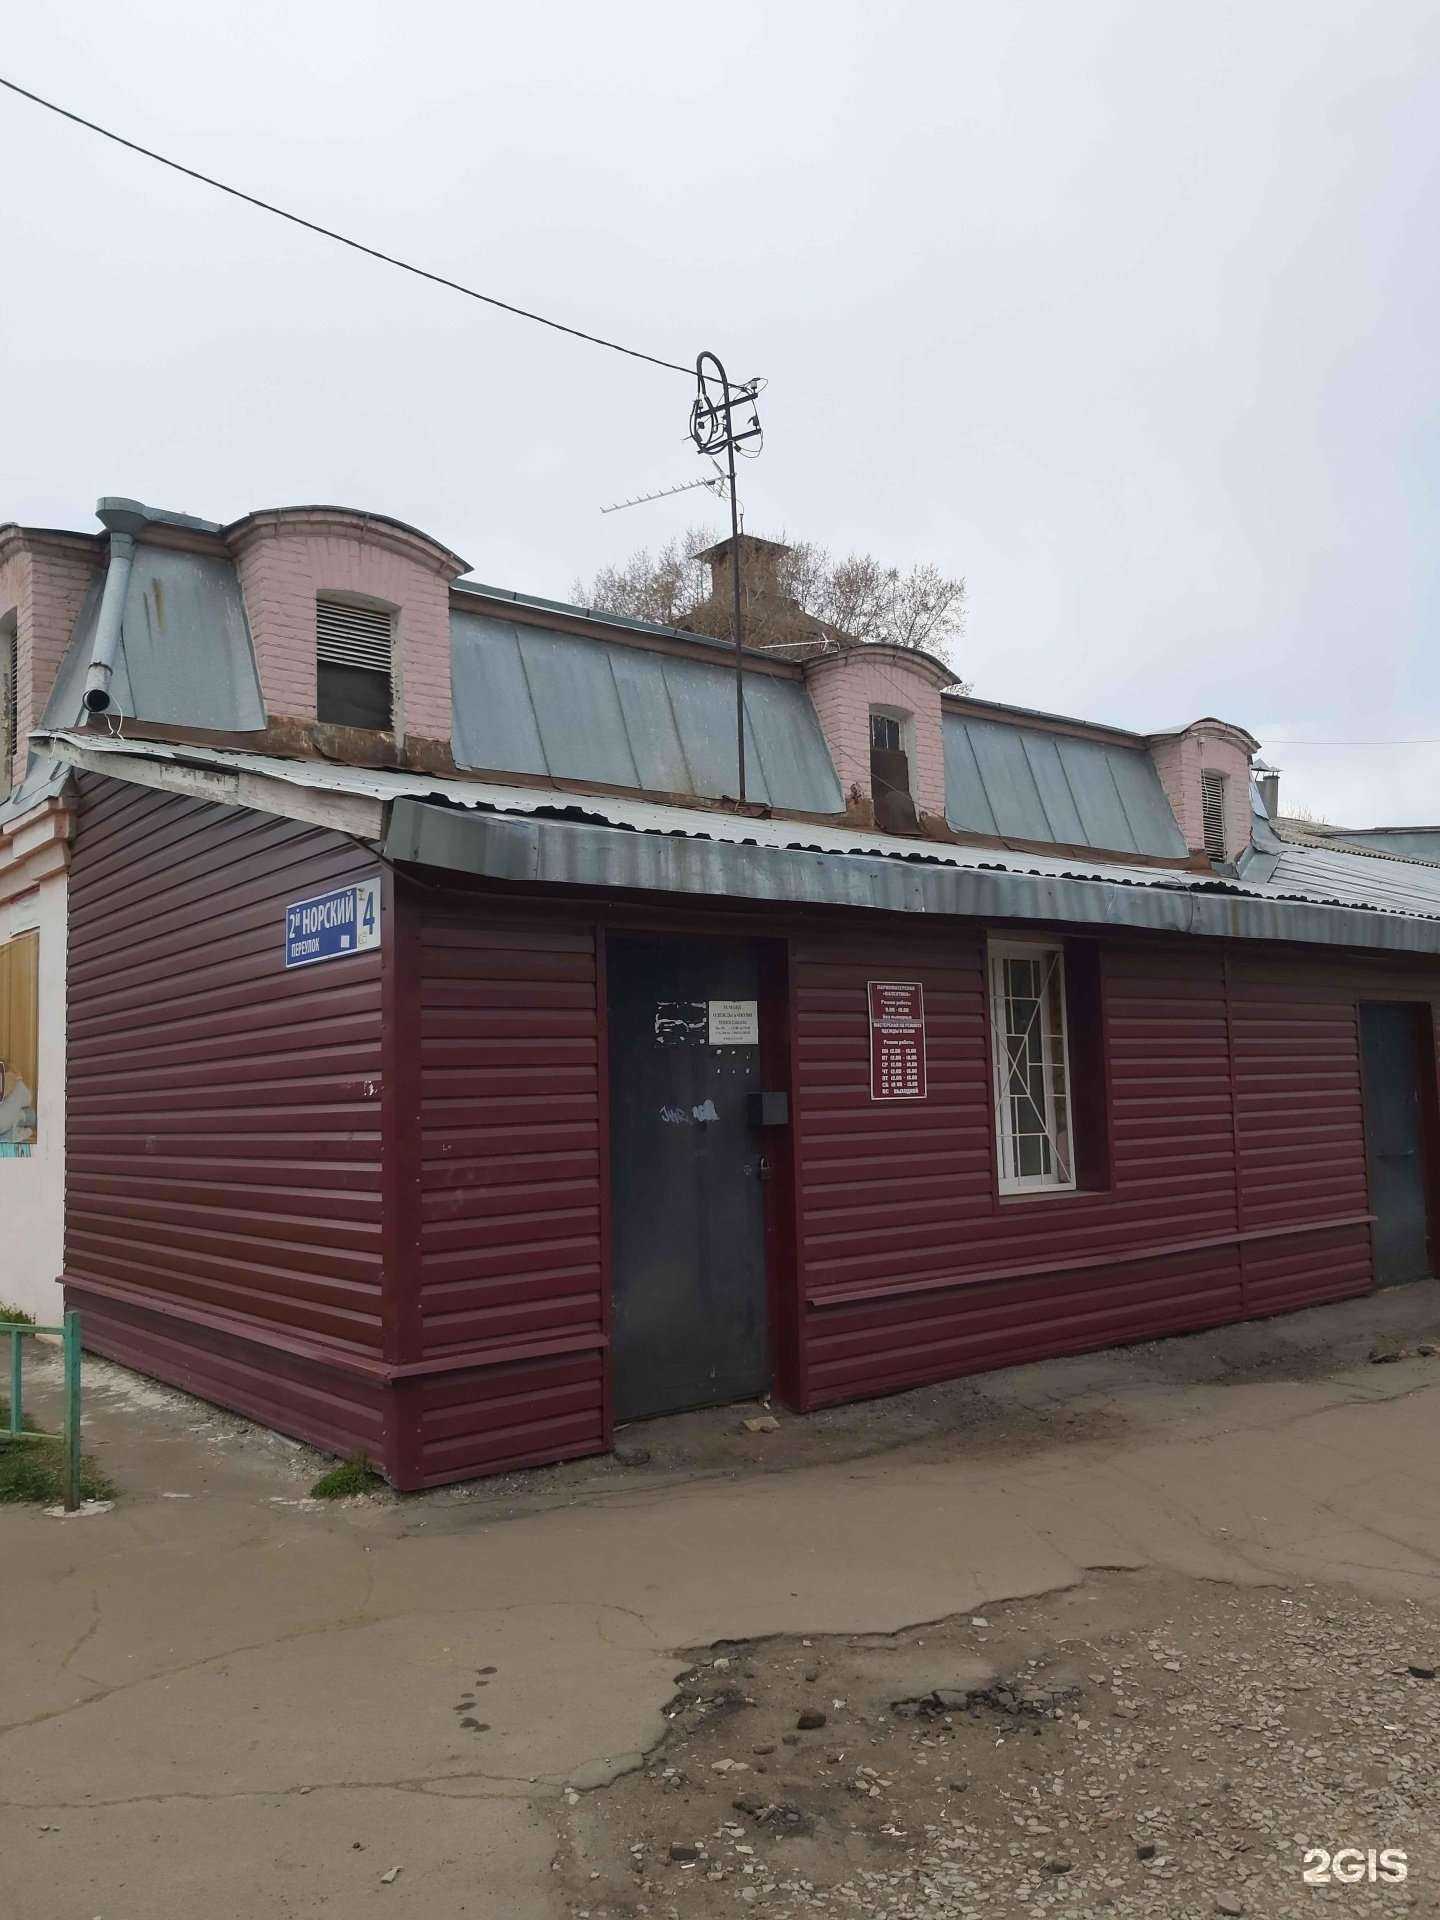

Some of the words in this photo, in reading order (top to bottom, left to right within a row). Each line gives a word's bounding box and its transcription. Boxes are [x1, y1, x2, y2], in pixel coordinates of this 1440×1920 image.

[302, 891, 354, 936] НОРСКИЙ
[362, 892, 376, 936] 4
[291, 938, 321, 958] ПЕРЕУЛОК
